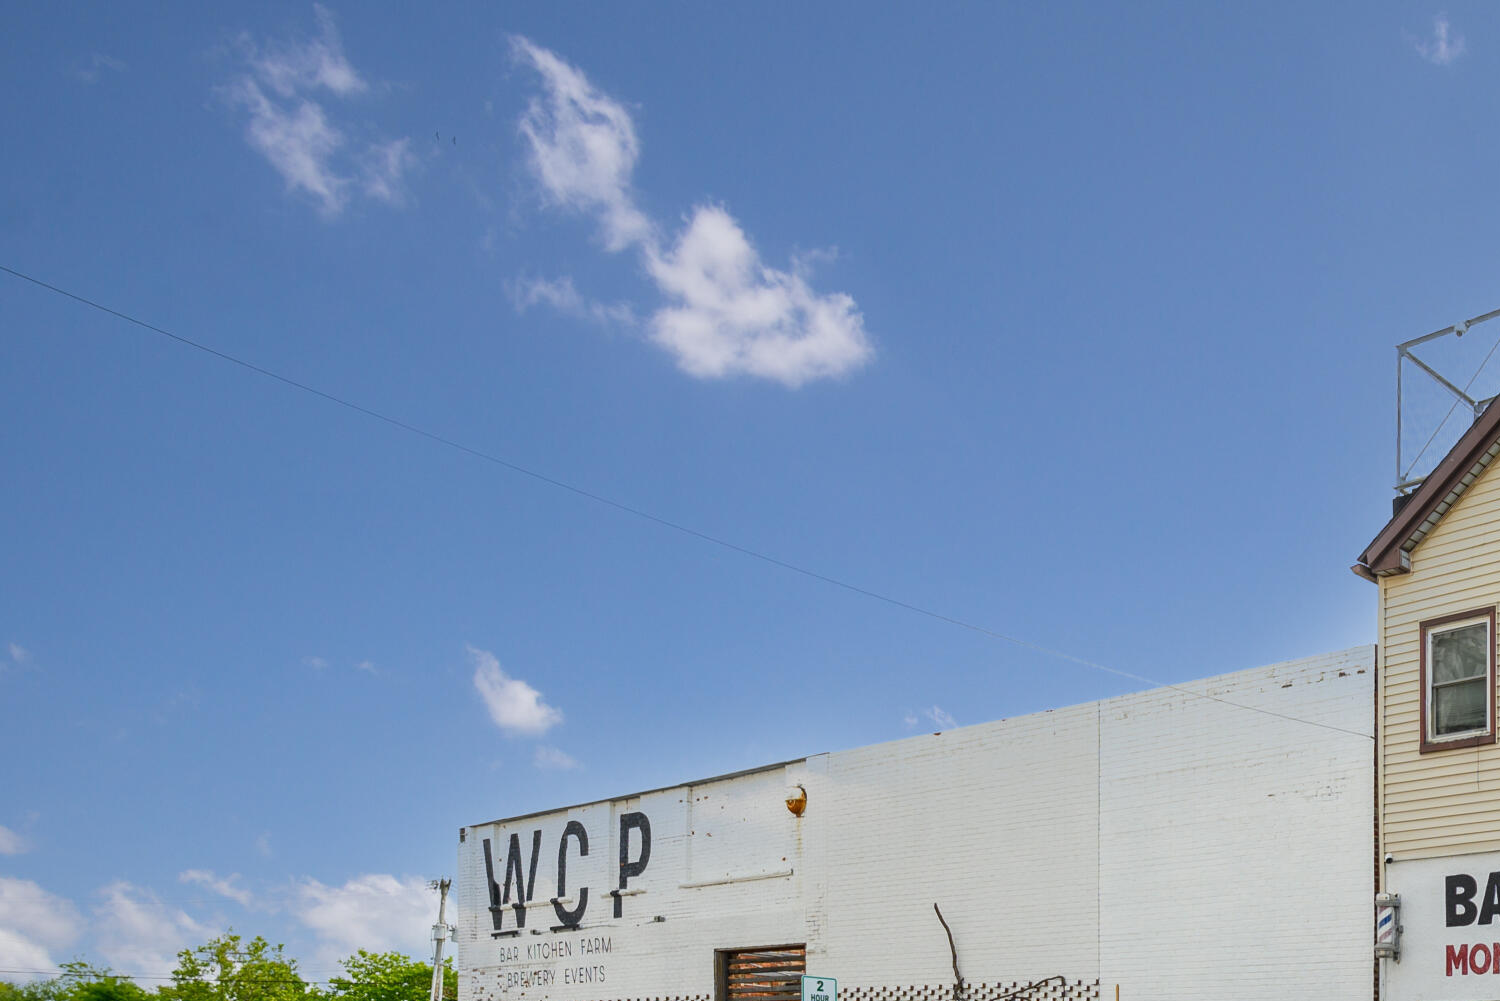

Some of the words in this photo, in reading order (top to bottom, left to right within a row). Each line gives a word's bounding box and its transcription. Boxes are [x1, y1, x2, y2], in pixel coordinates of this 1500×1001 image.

[483, 811, 651, 930] WCP
[500, 946, 519, 963] BAR
[527, 941, 572, 960] KITCHEN
[581, 936, 613, 956] FARM
[507, 969, 556, 988] BREWERY
[564, 965, 606, 985] EVENTS
[816, 980, 825, 992] 2
